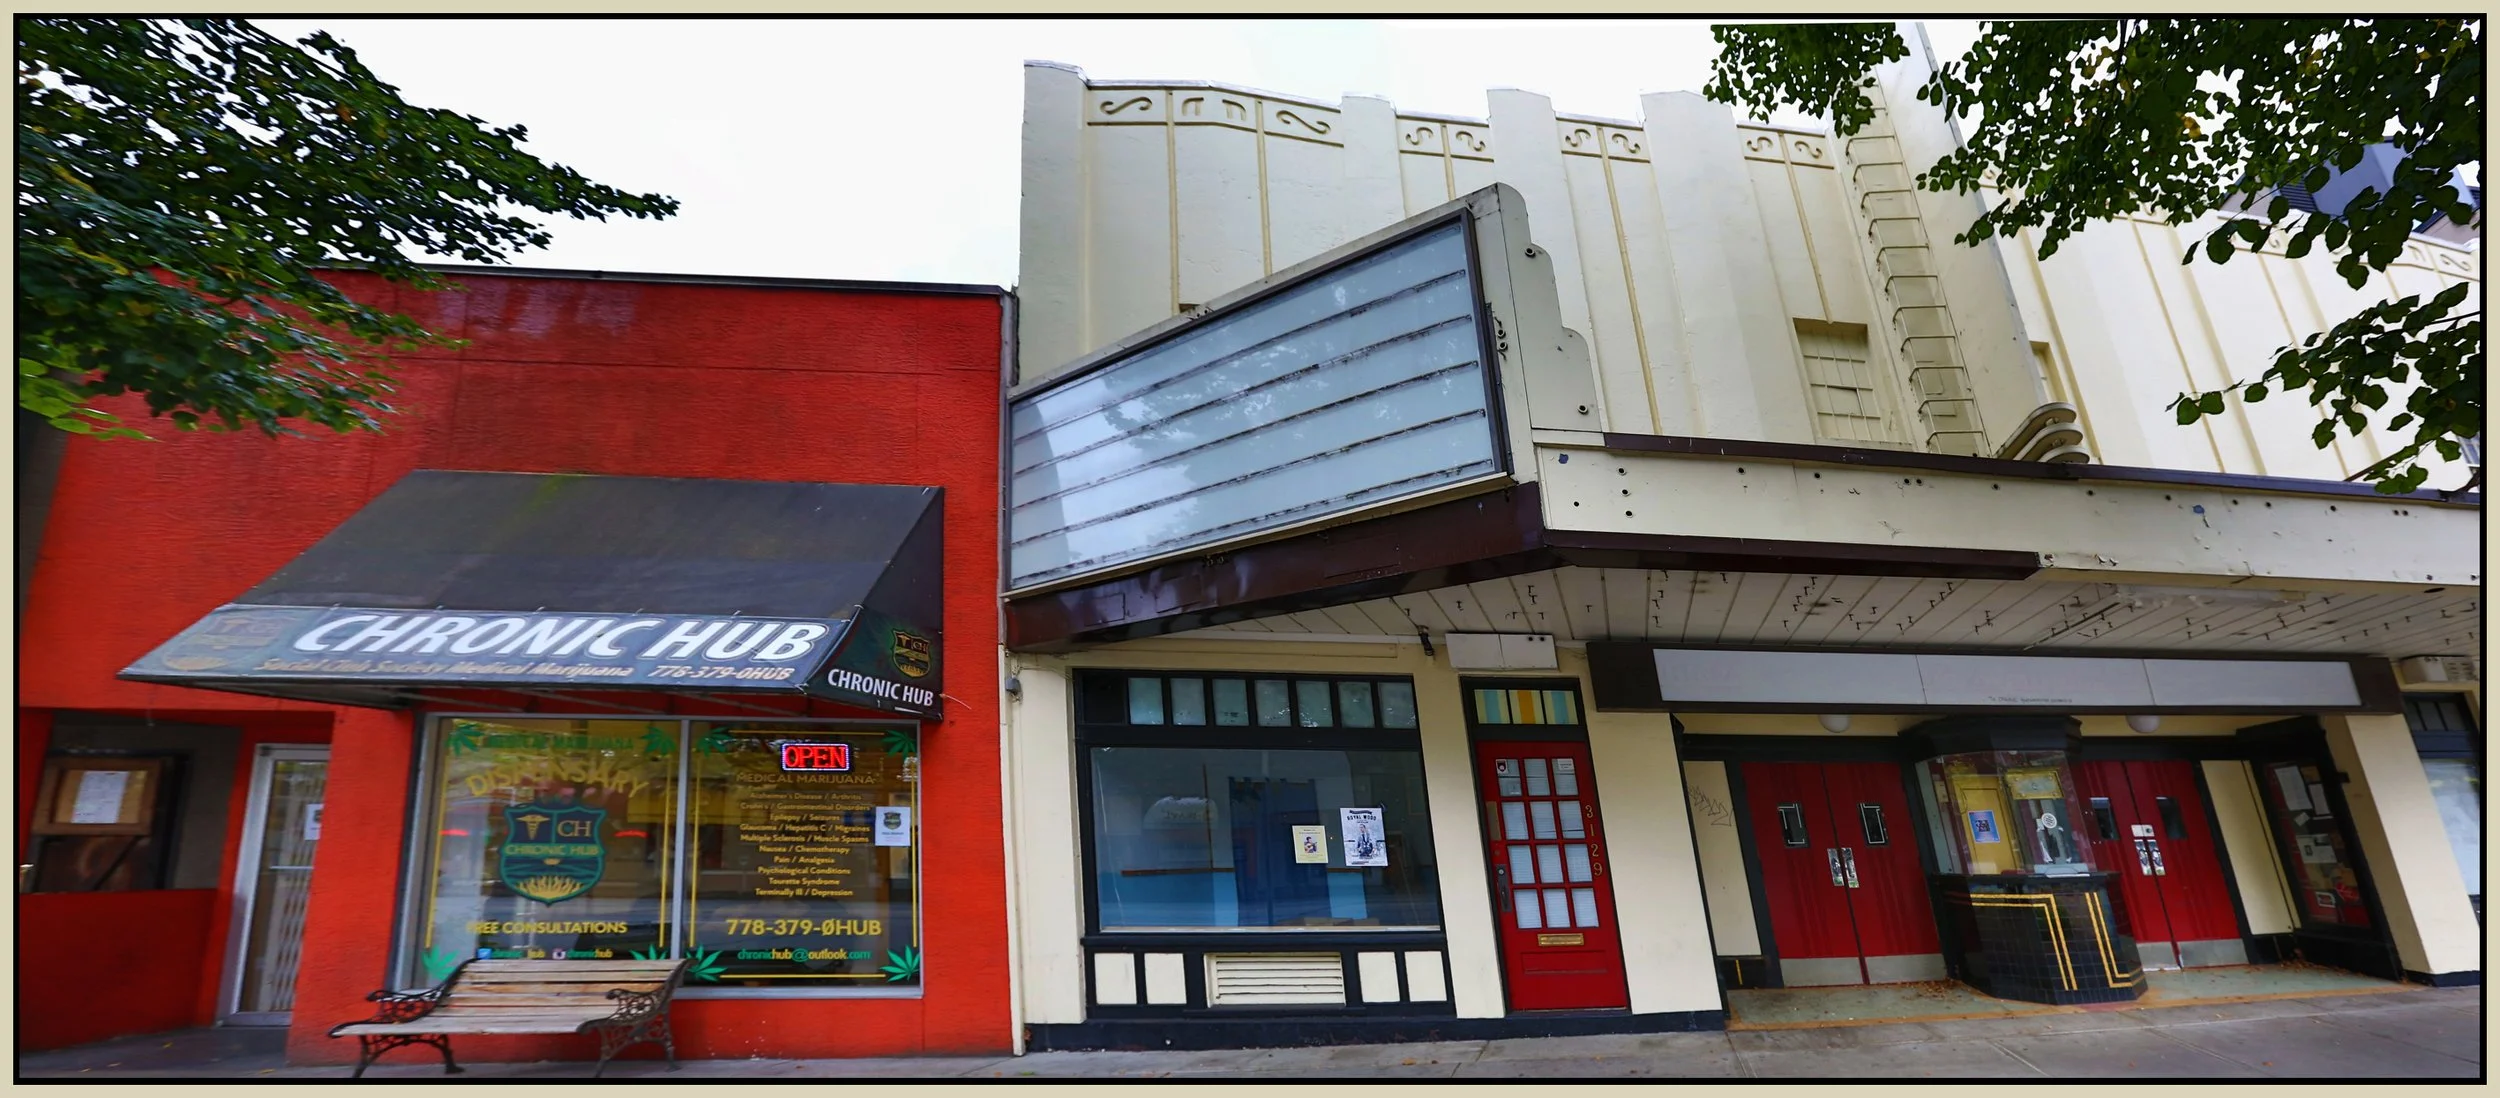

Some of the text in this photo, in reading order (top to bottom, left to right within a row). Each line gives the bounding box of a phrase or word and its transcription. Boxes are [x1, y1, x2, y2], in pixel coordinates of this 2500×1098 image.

[294, 615, 827, 661] CHRONIC HUB
[446, 661, 532, 675] Medical
[530, 663, 634, 678] Marijuana
[647, 665, 796, 681] 778-379-0HUB
[827, 668, 934, 707] CHRONIC HUB
[785, 746, 846, 768] OPEN
[736, 773, 876, 785] MEDICAL MARIJUANA
[557, 820, 592, 837] CH
[1585, 804, 1603, 876] 3129
[794, 845, 851, 855] Chemotherapy
[774, 855, 790, 864] Pain
[757, 866, 852, 876] Psychological Conditions
[801, 877, 841, 887] Syndrome
[755, 888, 795, 898] Terminally
[811, 888, 854, 898] Depression
[502, 921, 628, 935] CONSULTATIONS
[738, 949, 871, 962] chronichub@outlook.com
